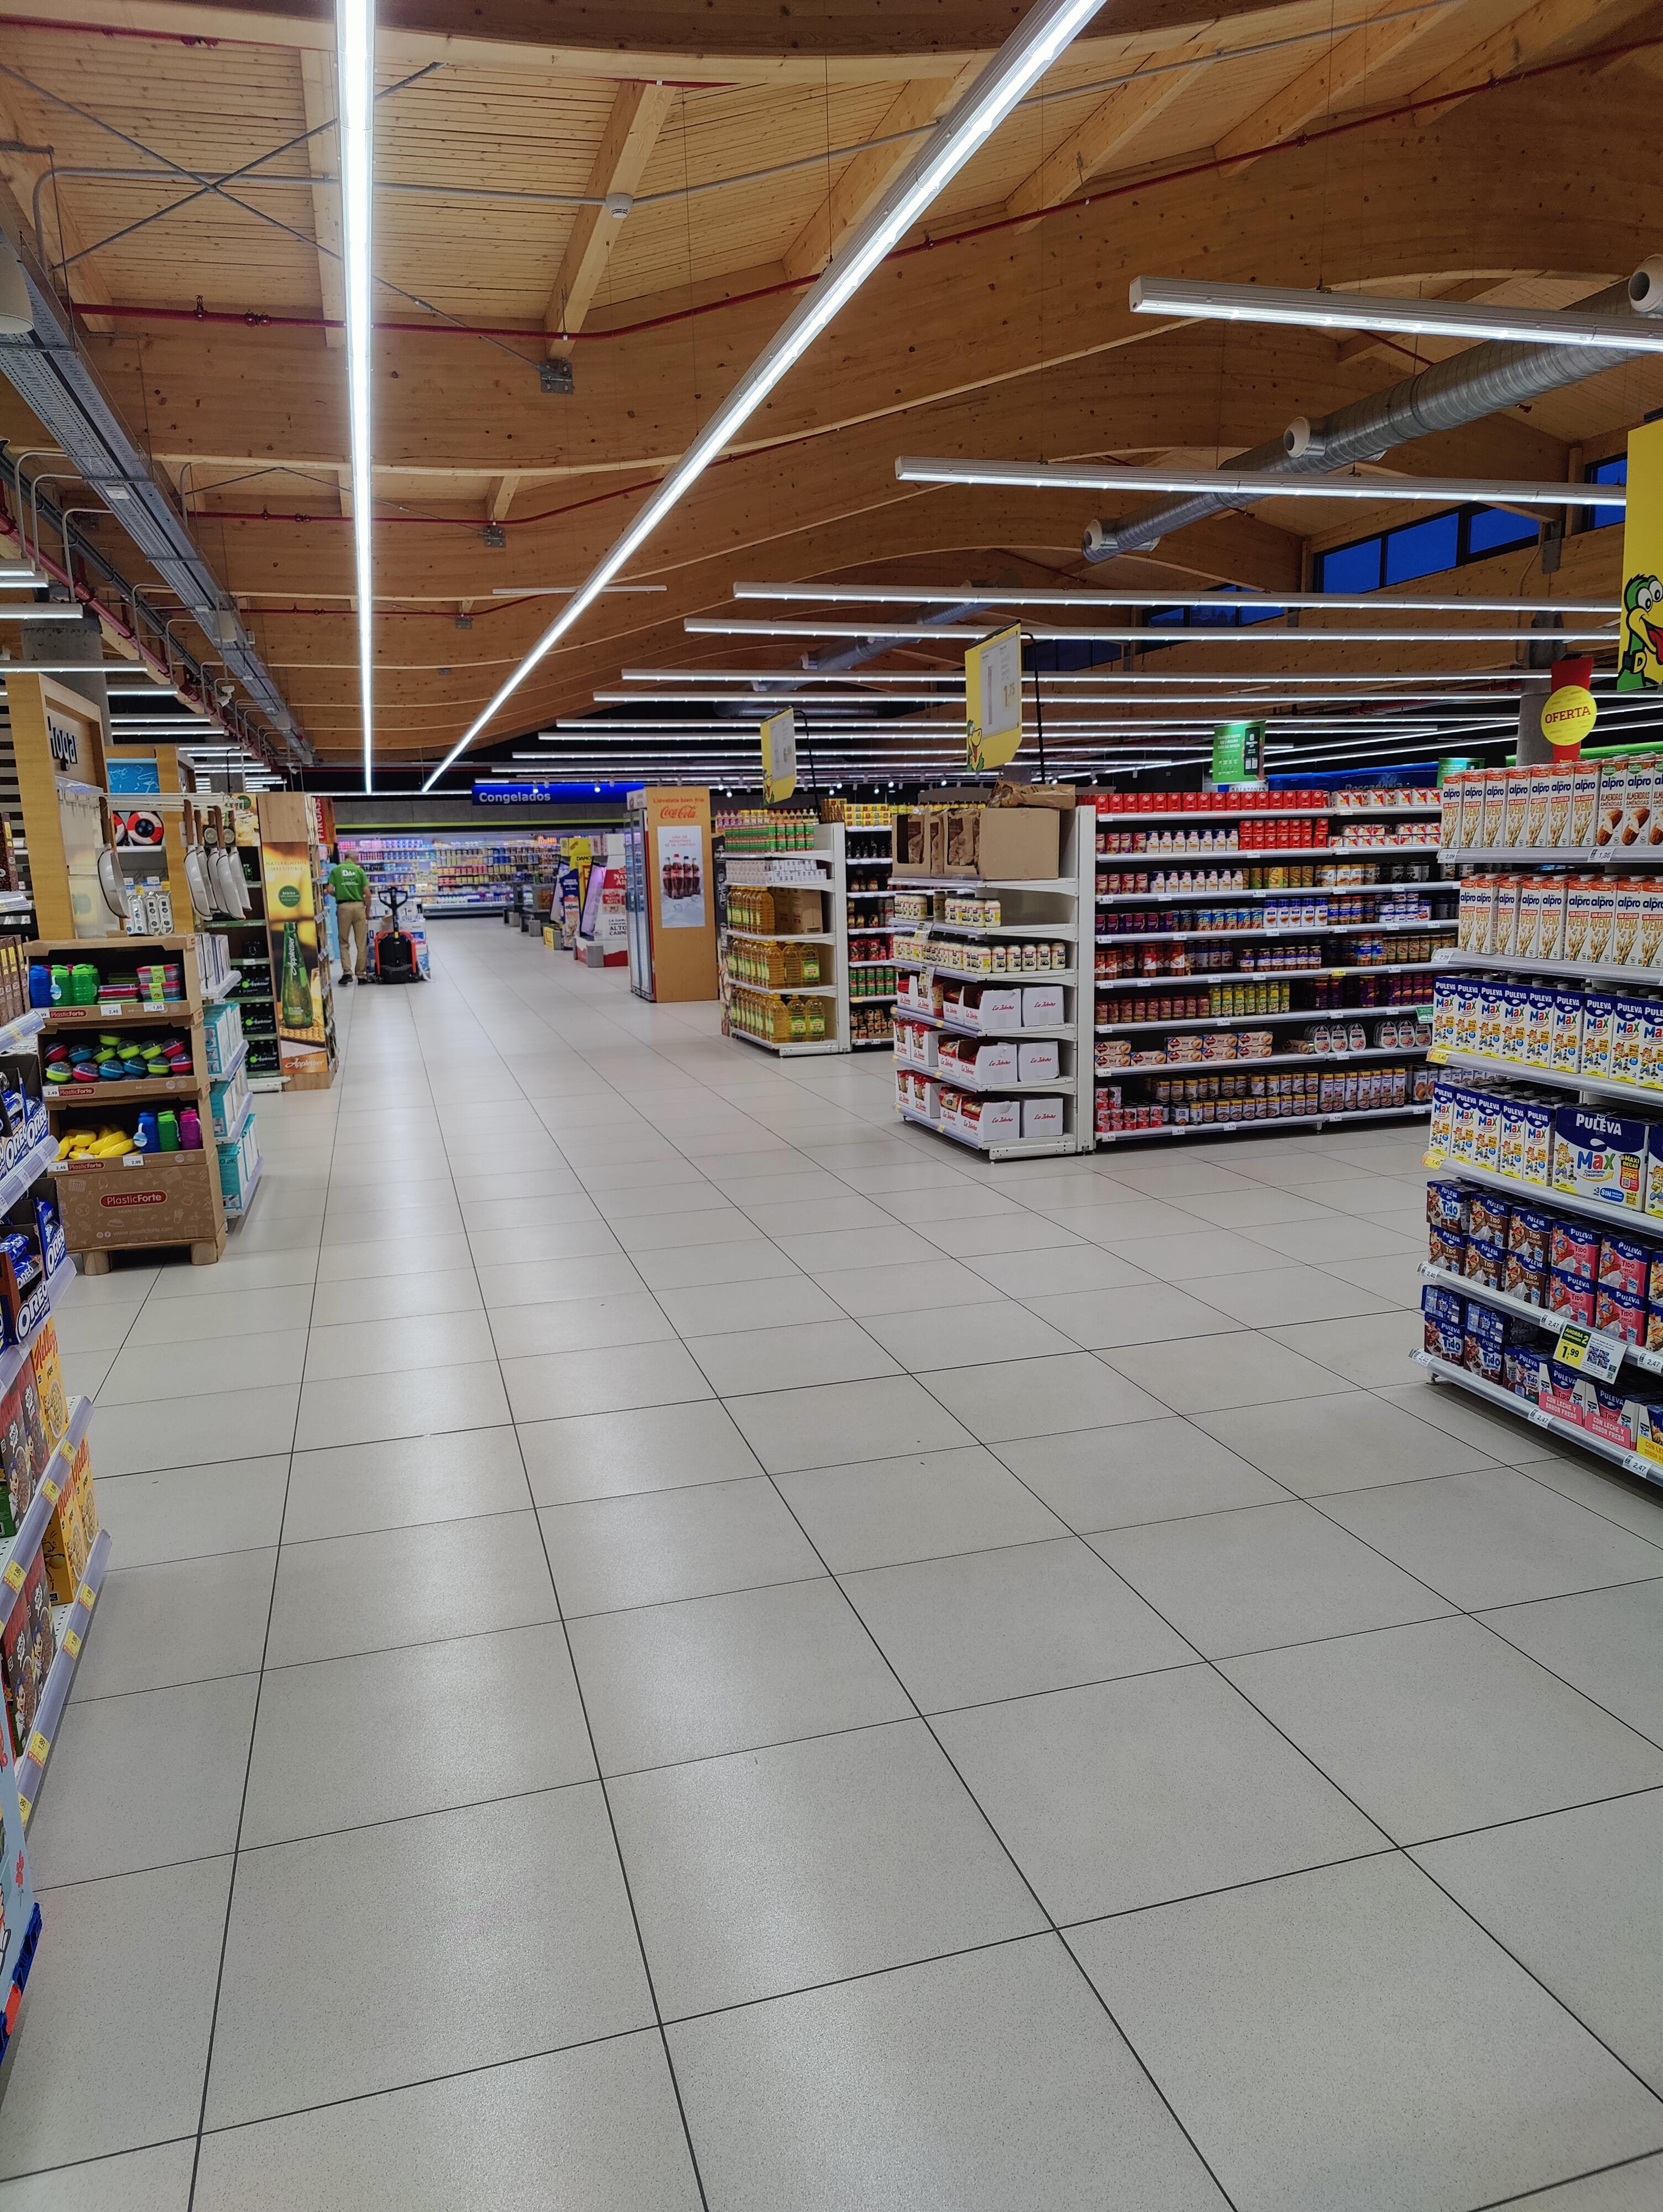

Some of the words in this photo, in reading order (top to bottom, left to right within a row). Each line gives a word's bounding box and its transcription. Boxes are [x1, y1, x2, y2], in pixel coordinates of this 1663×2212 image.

[1545, 706, 1591, 724] OFERTA
[1551, 781, 1571, 794] alpro
[1576, 779, 1595, 792] alpro
[1602, 777, 1624, 790] alpro
[1628, 775, 1651, 789] alpro
[1444, 788, 1460, 800] alpro
[1465, 787, 1482, 799] alpro
[1487, 786, 1504, 797] alpro
[1509, 784, 1528, 796] alpro
[1532, 782, 1549, 795] alpro
[479, 792, 551, 804] Congelados
[1461, 892, 1476, 904] alpro
[1477, 893, 1491, 905] alpro
[1499, 893, 1514, 905] alpro
[1522, 894, 1540, 906] alpro
[1542, 894, 1562, 907] alpro
[1591, 896, 1614, 909] alpro
[1476, 913, 1489, 921] AVENA
[1499, 914, 1513, 923] AVENA
[1520, 915, 1538, 925] AVENA
[1542, 916, 1560, 926] AVENA
[1568, 917, 1588, 927] AVENA
[1590, 919, 1611, 928] AVENA
[287, 937, 297, 977] Appletiser
[1436, 982, 1456, 990] PULEVA
[1458, 984, 1478, 993] PULEVA
[1481, 987, 1503, 997] PULEVA
[1504, 990, 1526, 999] PULEVA
[1437, 998, 1453, 1008] Max
[1530, 993, 1552, 1003] PULEVA
[1557, 996, 1580, 1006] PULEVA
[1458, 1001, 1476, 1011] Max
[1482, 1004, 1500, 1014] Max
[1587, 1000, 1611, 1010] PULEVA
[1617, 1003, 1642, 1014] PULEVA
[1505, 1007, 1525, 1018] Max
[1530, 1010, 1550, 1021] Max
[1645, 1007, 1663, 1016] PULE
[1557, 1014, 1577, 1025] Max
[1587, 1018, 1609, 1029] Max
[1617, 1022, 1640, 1033] Max
[285, 1058, 324, 1068] Appletiser
[1435, 1088, 1452, 1099] PULEVA
[1457, 1093, 1477, 1104] PULEVA
[1434, 1104, 1450, 1114] Max
[1478, 1099, 1499, 1110] PULEVA
[1456, 1110, 1474, 1120] Max
[1503, 1105, 1524, 1117] PULEVA
[1528, 1110, 1548, 1122] PULEVA
[27, 1105, 46, 1148] OREO
[1478, 1117, 1498, 1126] Max
[1576, 1113, 1622, 1136] PULEVA
[1504, 1123, 1522, 1133] Max
[6, 1126, 27, 1169] OREO
[1601, 1189, 1611, 1197] SIN
[107, 1193, 161, 1205] PlasticForte
[1441, 1201, 1458, 1215] Tido
[1490, 1215, 1500, 1224] TIDO
[1529, 1231, 1540, 1240] TIDO
[46, 1225, 65, 1276] OREO
[1446, 1246, 1456, 1255] TIDO
[1575, 1245, 1587, 1254] TIDO
[1484, 1260, 1494, 1268] TIDO
[1622, 1260, 1635, 1269] TIDO
[1572, 1293, 1584, 1302] TIDO
[17, 1280, 48, 1338] OREO
[1620, 1310, 1633, 1318] TIDO
[1566, 1328, 1583, 1338] AHORRA
[1582, 1335, 1589, 1344] 2
[1442, 1337, 1460, 1350] Tido
[1562, 1346, 1579, 1358] 1,99
[1483, 1353, 1500, 1365] Tido
[1647, 1359, 1660, 1368] 2,47
[1557, 1400, 1572, 1408] LECHE
[1546, 1402, 1560, 1412] SABOR
[1561, 1409, 1576, 1420] FRESA
[1604, 1412, 1618, 1421] TIDO
[1537, 1415, 1548, 1423] 2,47
[1593, 1417, 1603, 1425] CON
[1604, 1421, 1619, 1432] LECHE
[1592, 1423, 1607, 1436] SABOR
[1608, 1431, 1624, 1442] FRESA
[1633, 1463, 1646, 1472] 2,47
